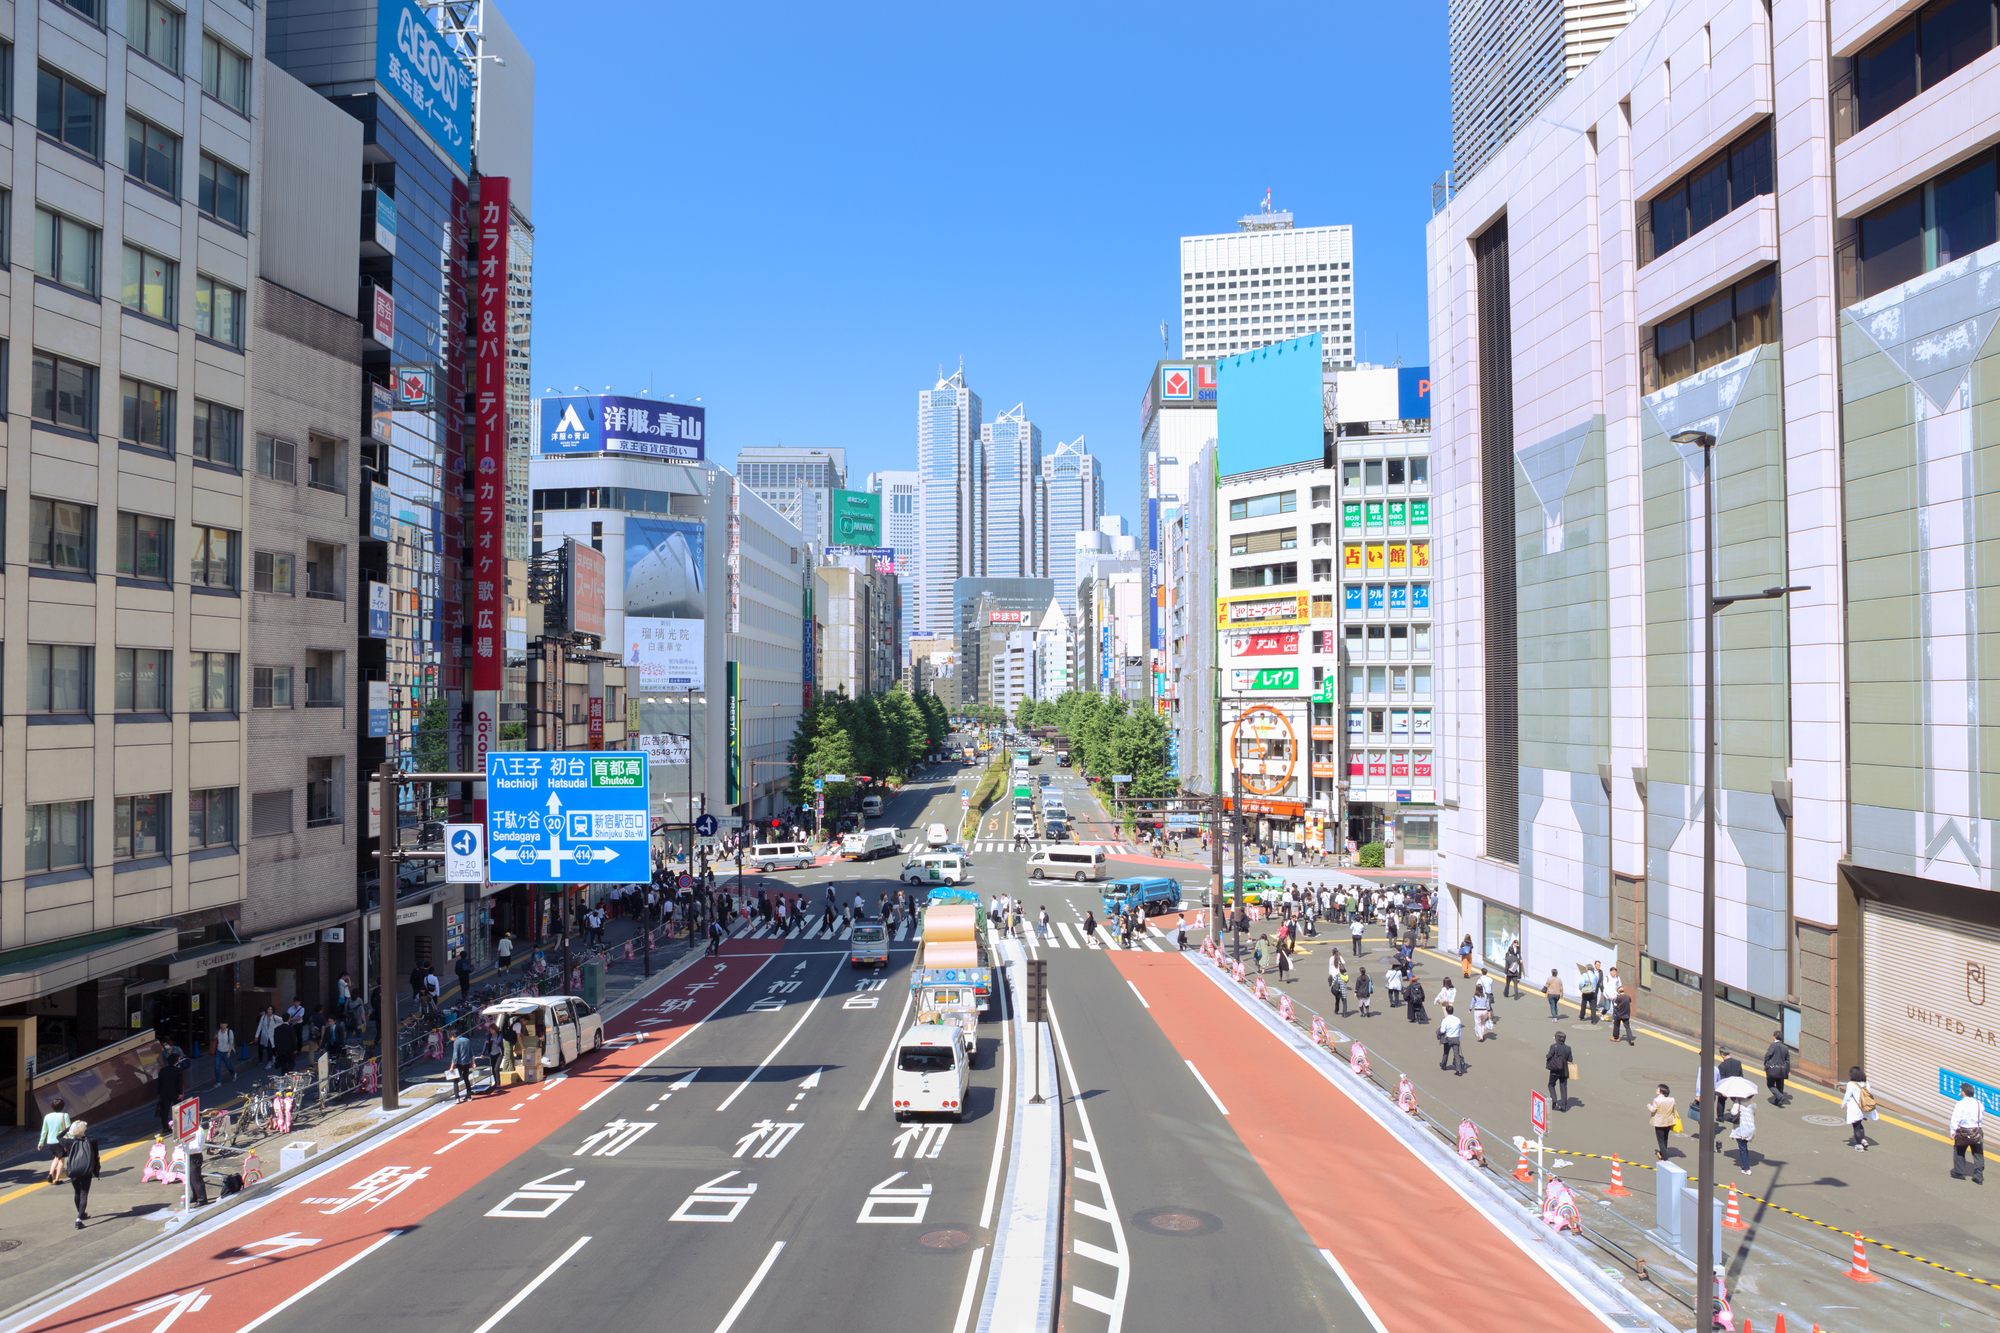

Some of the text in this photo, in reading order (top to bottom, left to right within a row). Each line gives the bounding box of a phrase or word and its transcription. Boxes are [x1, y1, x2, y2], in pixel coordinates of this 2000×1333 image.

[397, 7, 459, 111] AEON
[458, 67, 470, 89] 6F
[388, 52, 463, 147] 英会話イーオン
[603, 405, 702, 441] 洋服の青山
[551, 432, 590, 441] 洋服の青山
[619, 440, 688, 456] 京王百貨店向い
[373, 500, 388, 513] 英会話
[1346, 505, 1359, 513] 8F
[1369, 503, 1403, 514] 整体
[371, 512, 390, 526] イーオン
[853, 522, 874, 532] MIWA
[577, 553, 593, 571] SUPER
[1150, 549, 1158, 570] JUST
[1346, 547, 1405, 565] 占い館
[1219, 603, 1228, 624] 7F
[1248, 604, 1297, 617] エーアイアール
[1298, 596, 1309, 619] 賃貸
[991, 612, 1020, 621] やまや
[642, 627, 690, 641] 瑠璃光院
[1285, 634, 1296, 643] 6F
[648, 641, 683, 652] 白蓮華堂
[1256, 638, 1278, 650] アコム
[1262, 670, 1294, 686] レイク
[591, 703, 603, 731] 指圧
[1348, 719, 1362, 727] 賃貸
[1415, 719, 1430, 728] タイ
[641, 735, 688, 746] 広告募集中
[491, 757, 586, 776] 八王子 初台
[593, 760, 641, 776] 首都高
[1369, 766, 1385, 774] 新宿
[1392, 766, 1408, 774] ICT
[496, 778, 588, 791] Hachioji Hatsudai
[599, 776, 635, 786] Shutoko
[1250, 804, 1274, 813] Kitchen
[548, 818, 562, 830] 20
[594, 813, 644, 829] 新宿駅西口
[492, 831, 541, 844] Sendagaya
[594, 830, 623, 840] Shinjuku
[519, 849, 535, 860] 414
[575, 849, 591, 860] 414
[453, 860, 476, 869] 7-20
[450, 869, 481, 878] この先50m
[402, 911, 418, 920] SELECT
[746, 979, 803, 1013] 初台
[842, 977, 888, 1010] 初台
[1906, 1004, 1997, 1047] UNITED AR
[482, 1118, 658, 1218] 初台
[668, 1119, 805, 1222] 初台
[856, 1122, 953, 1225] 初台
